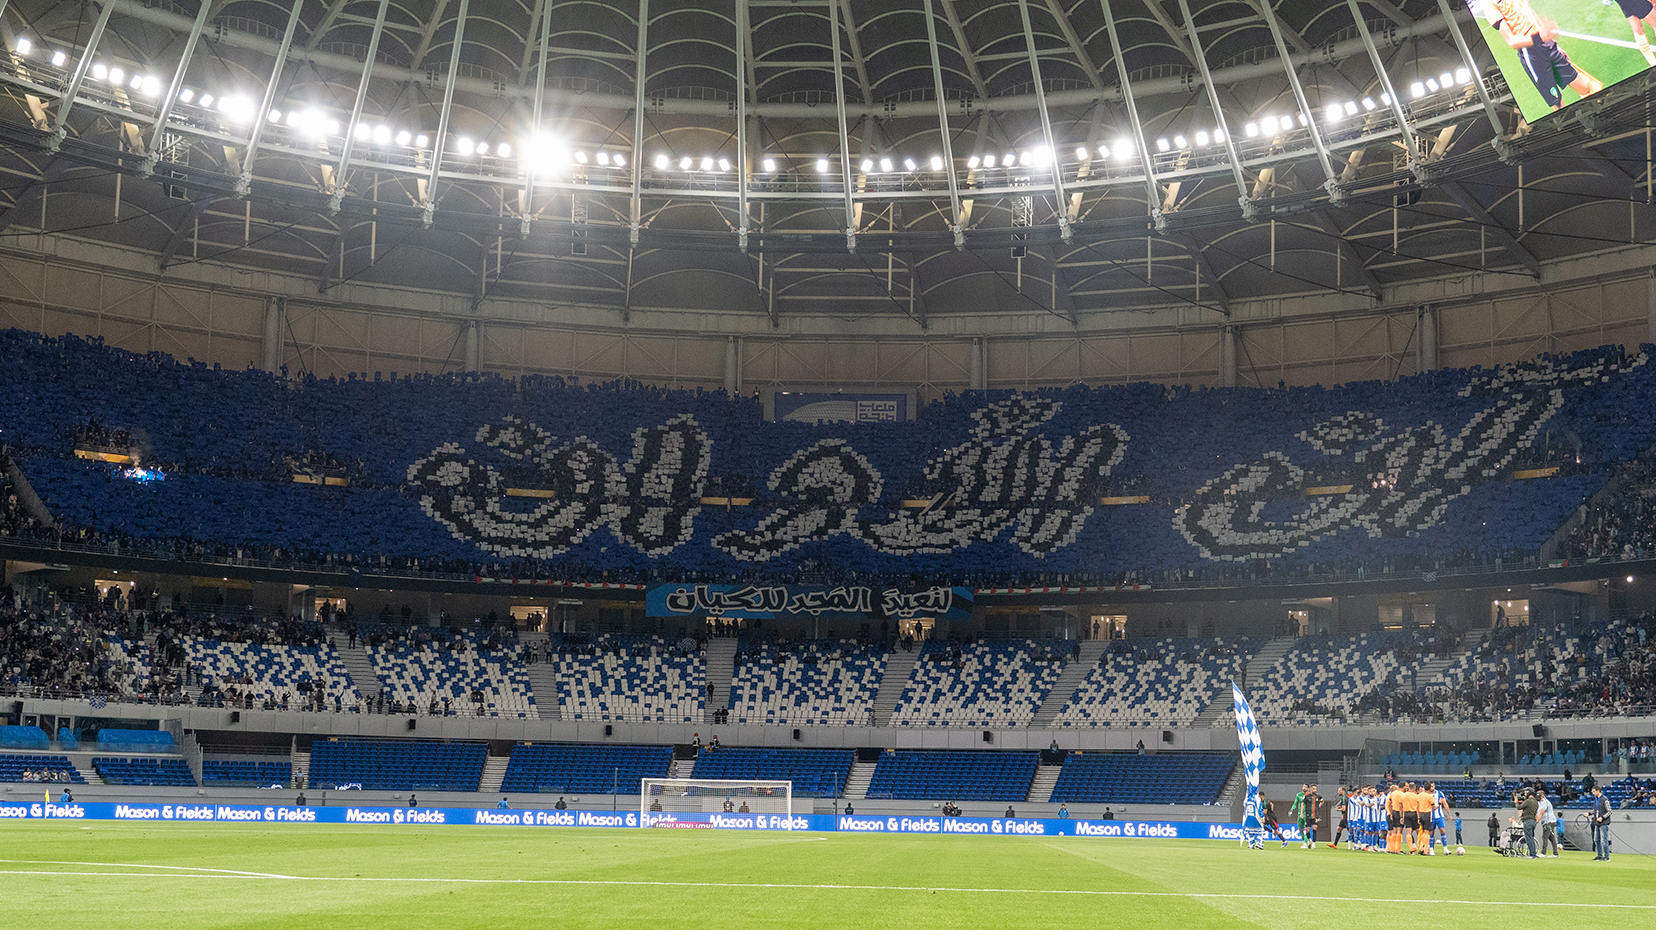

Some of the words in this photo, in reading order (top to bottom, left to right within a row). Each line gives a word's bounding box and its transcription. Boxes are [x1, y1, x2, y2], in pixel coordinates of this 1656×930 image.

[665, 585, 788, 615] للكيان
[787, 586, 872, 615] المجد
[30, 803, 43, 817] &
[46, 804, 85, 818] Fields
[114, 804, 160, 819] Mason
[162, 805, 174, 819] &
[176, 806, 214, 820] Fields
[216, 806, 262, 820] Mason
[264, 807, 276, 821] &
[278, 808, 316, 822] Fields
[346, 808, 391, 823] Mason
[393, 809, 405, 823] &
[407, 810, 446, 823] Fields
[476, 811, 521, 825] Mason
[523, 811, 535, 825] &
[537, 812, 575, 826] Fields
[578, 812, 623, 826] Mason
[626, 813, 637, 827] &
[709, 814, 754, 829] Mason
[756, 815, 768, 829] &
[769, 815, 809, 830] Fields
[840, 816, 885, 831] Mason
[887, 817, 899, 832] &
[901, 818, 940, 832] Fields
[944, 818, 989, 833] Mason
[991, 819, 1003, 834] &
[1005, 820, 1045, 834] Fields
[1076, 821, 1121, 836] Mason
[1123, 822, 1136, 836] &
[1138, 823, 1178, 837] Fields
